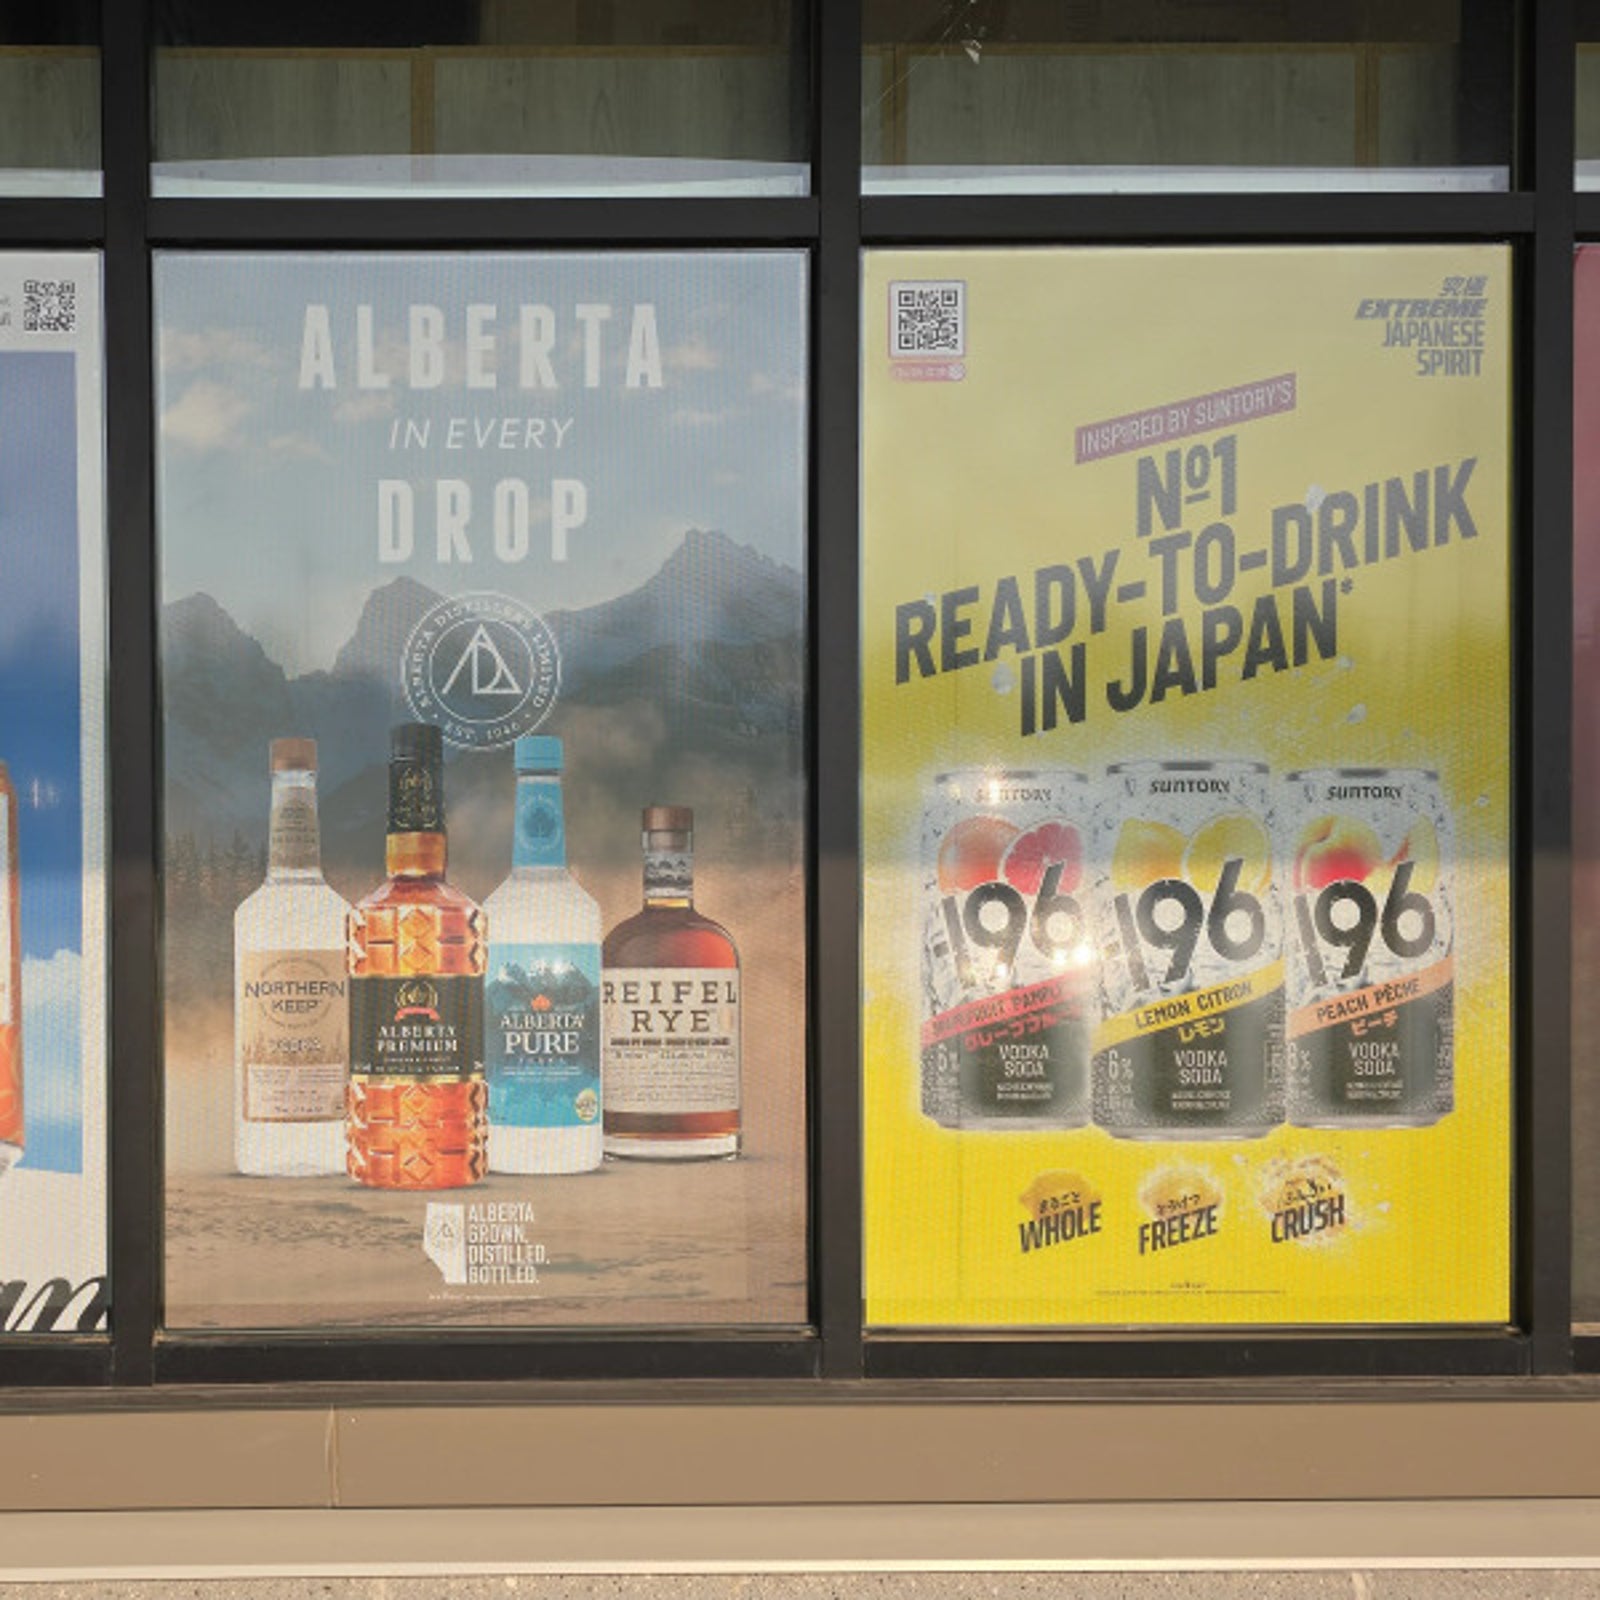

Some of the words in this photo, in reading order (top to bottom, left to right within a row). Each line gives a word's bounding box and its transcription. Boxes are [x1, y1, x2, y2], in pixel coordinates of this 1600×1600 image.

[1355, 298, 1489, 321] EXTREME
[1382, 319, 1487, 348] JAPANESE
[299, 302, 664, 390] ALBERTA
[1416, 348, 1484, 377] SPIRIT
[1081, 413, 1165, 455] INSPIRED
[1168, 407, 1191, 434] BY
[1194, 379, 1294, 427] SUNTORY'S
[388, 417, 432, 450] IN
[445, 417, 575, 450] EVERY
[377, 477, 588, 564] DROP
[1020, 642, 1087, 737] IN
[975, 787, 1053, 802] STORY
[1150, 778, 1231, 794] SUNTORY
[1327, 785, 1405, 801] SUNTORY
[244, 980, 346, 999] NORTHERN
[602, 980, 738, 1005] REIFEL
[272, 1000, 320, 1015] KEEP
[1134, 999, 1191, 1030] LEMON
[1196, 981, 1252, 1012] CITRON
[1316, 995, 1369, 1023] PEACH
[379, 1025, 457, 1039] ALBERTA
[500, 1012, 585, 1031] ALBERTA
[630, 1009, 711, 1034] RYE
[377, 1039, 459, 1053] PREMIUM
[504, 1030, 580, 1055] PURE
[998, 1044, 1050, 1060] VODKA
[1348, 1041, 1400, 1059] VODKA
[1004, 1060, 1045, 1078] SODA
[1173, 1050, 1228, 1068] VODKA
[1353, 1058, 1396, 1076] SODA
[1179, 1067, 1223, 1085] SODA
[468, 1201, 535, 1223] ALBERTA
[1018, 1200, 1103, 1254] WHOLE
[1138, 1203, 1219, 1256] FREEZE
[1270, 1193, 1346, 1244] CRUSH
[468, 1244, 551, 1266] DISTILLED.
